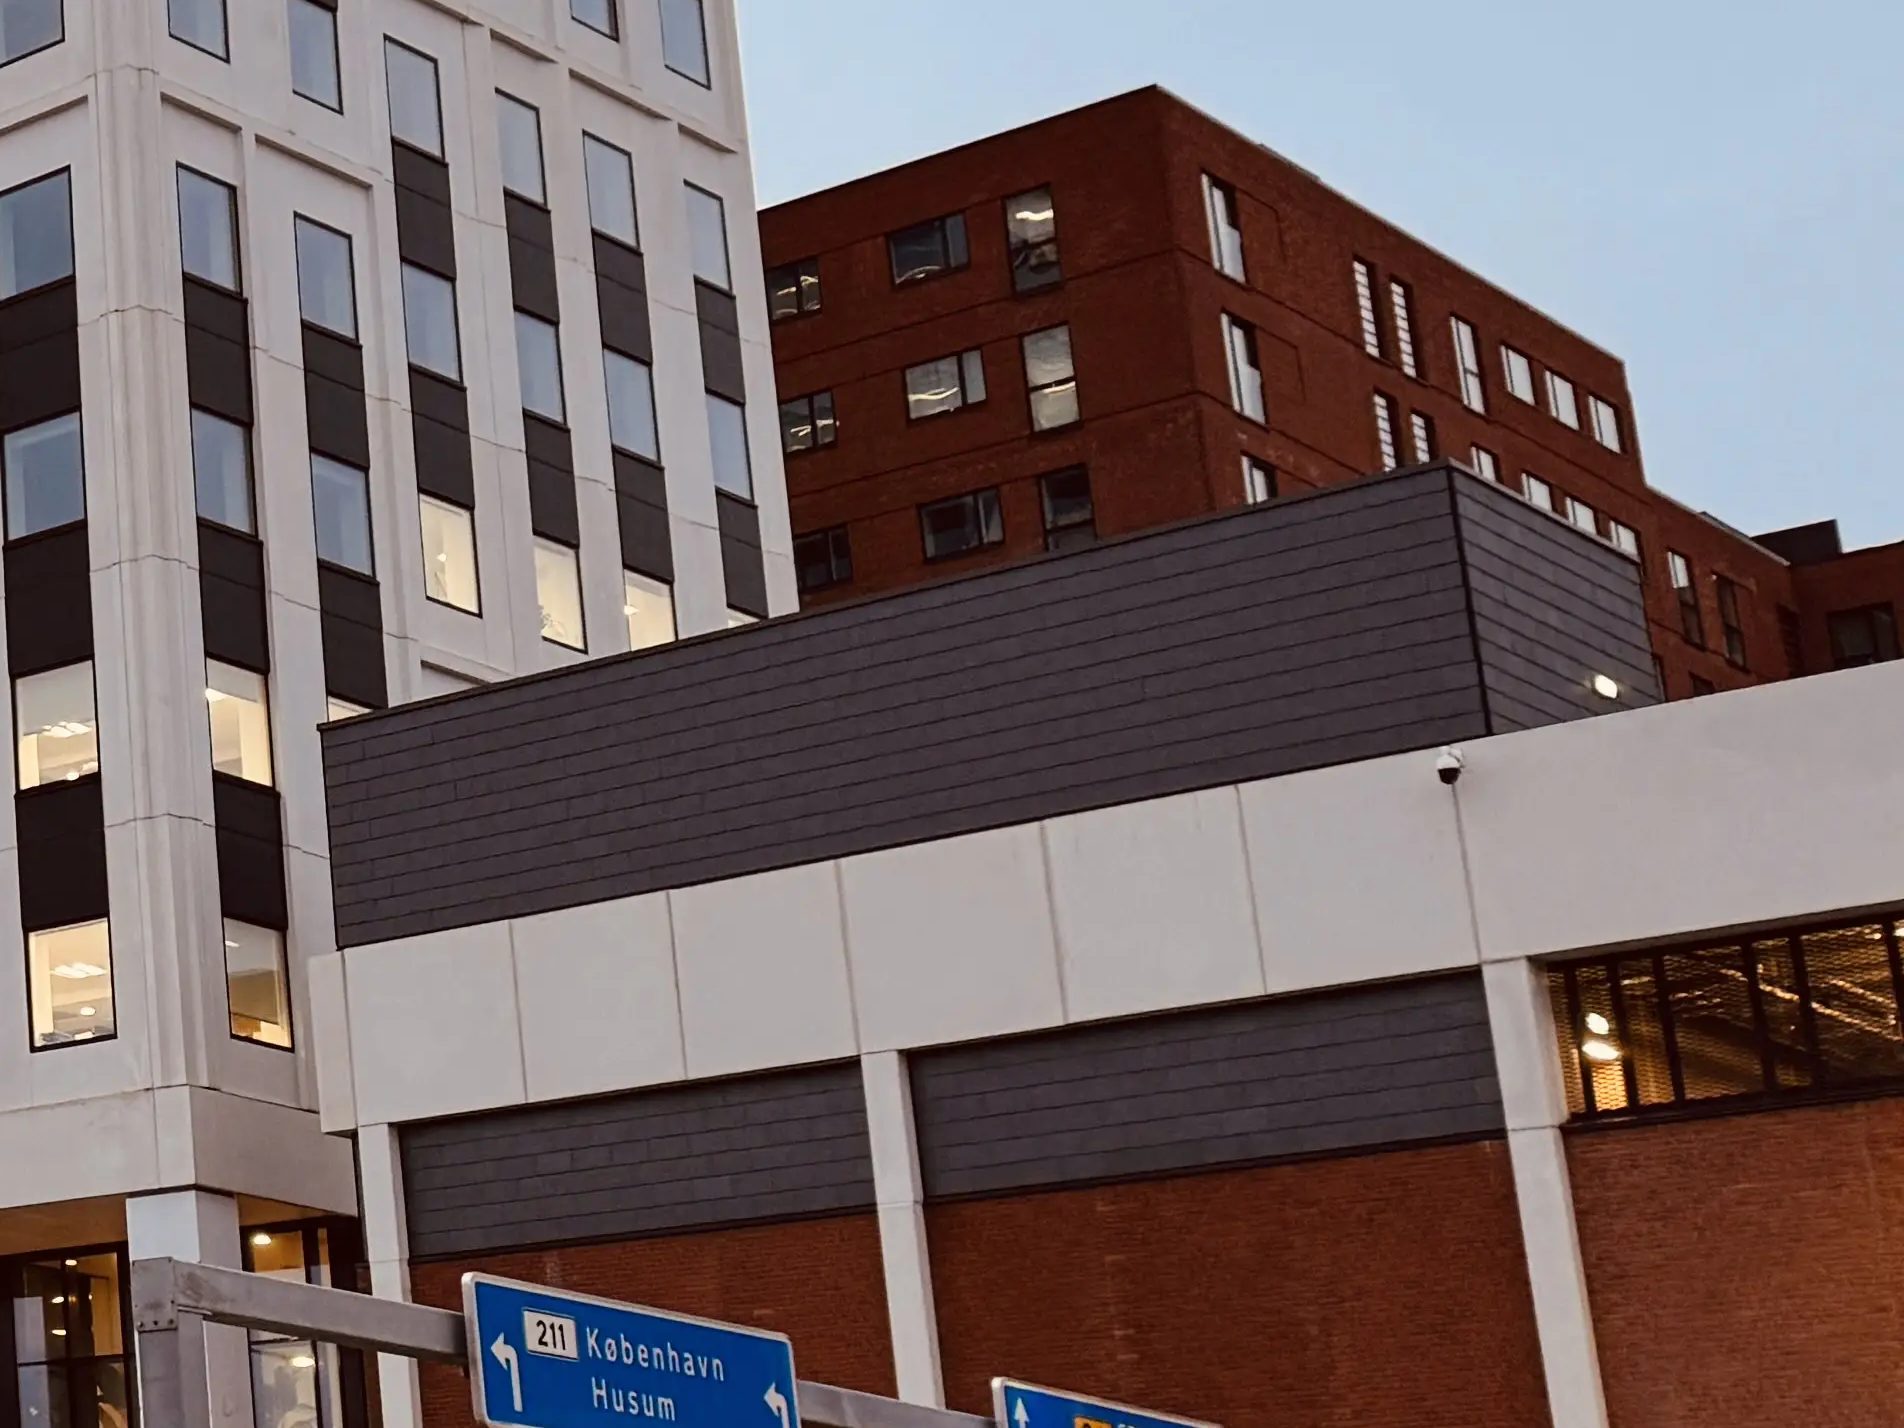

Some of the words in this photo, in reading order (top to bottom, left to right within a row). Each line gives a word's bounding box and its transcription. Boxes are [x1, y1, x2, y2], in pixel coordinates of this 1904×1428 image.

[535, 1319, 567, 1351] 211
[586, 1325, 725, 1382] København
[591, 1375, 677, 1422] Husum
